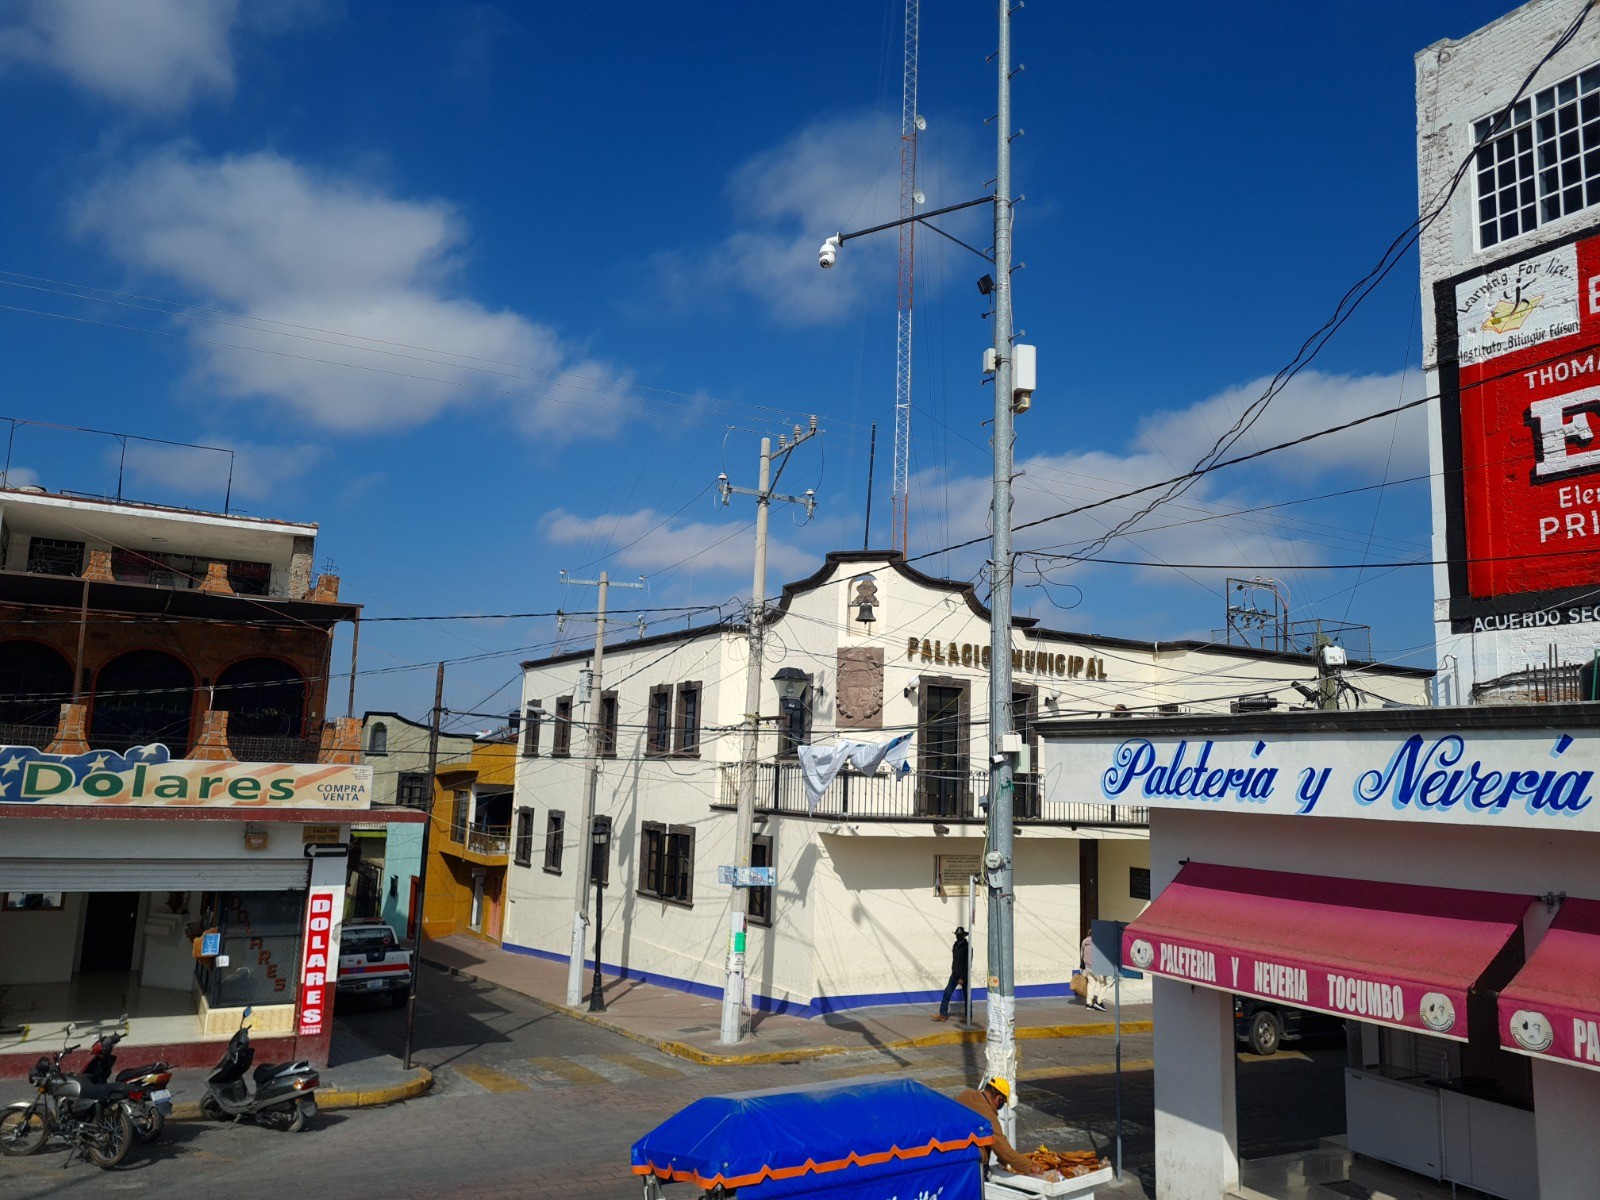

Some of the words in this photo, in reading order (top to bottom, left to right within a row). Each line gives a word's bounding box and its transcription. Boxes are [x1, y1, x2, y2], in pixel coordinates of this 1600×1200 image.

[1457, 273, 1509, 313] Learning
[1518, 263, 1541, 276] For
[1460, 341, 1502, 363] Instituto
[1549, 321, 1579, 338] Edison
[1524, 354, 1600, 389] THOM
[1558, 484, 1600, 509] Ele
[1473, 608, 1561, 632] ACUERDO
[907, 636, 991, 665] PALACIO
[1012, 648, 1107, 679] MUNICIPAL
[23, 762, 296, 801] Dolares
[317, 784, 365, 793] COMPRA
[1102, 738, 1279, 799] Paletería
[1297, 766, 1333, 814] y
[1355, 733, 1594, 814] Nevería
[322, 793, 359, 802] VENTA
[302, 899, 331, 1023] DOLARES
[1160, 942, 1216, 982] PALETERIA
[1231, 956, 1239, 987] Y
[1254, 960, 1308, 1002] NEVERIA
[1327, 973, 1404, 1021] TOCUMBO
